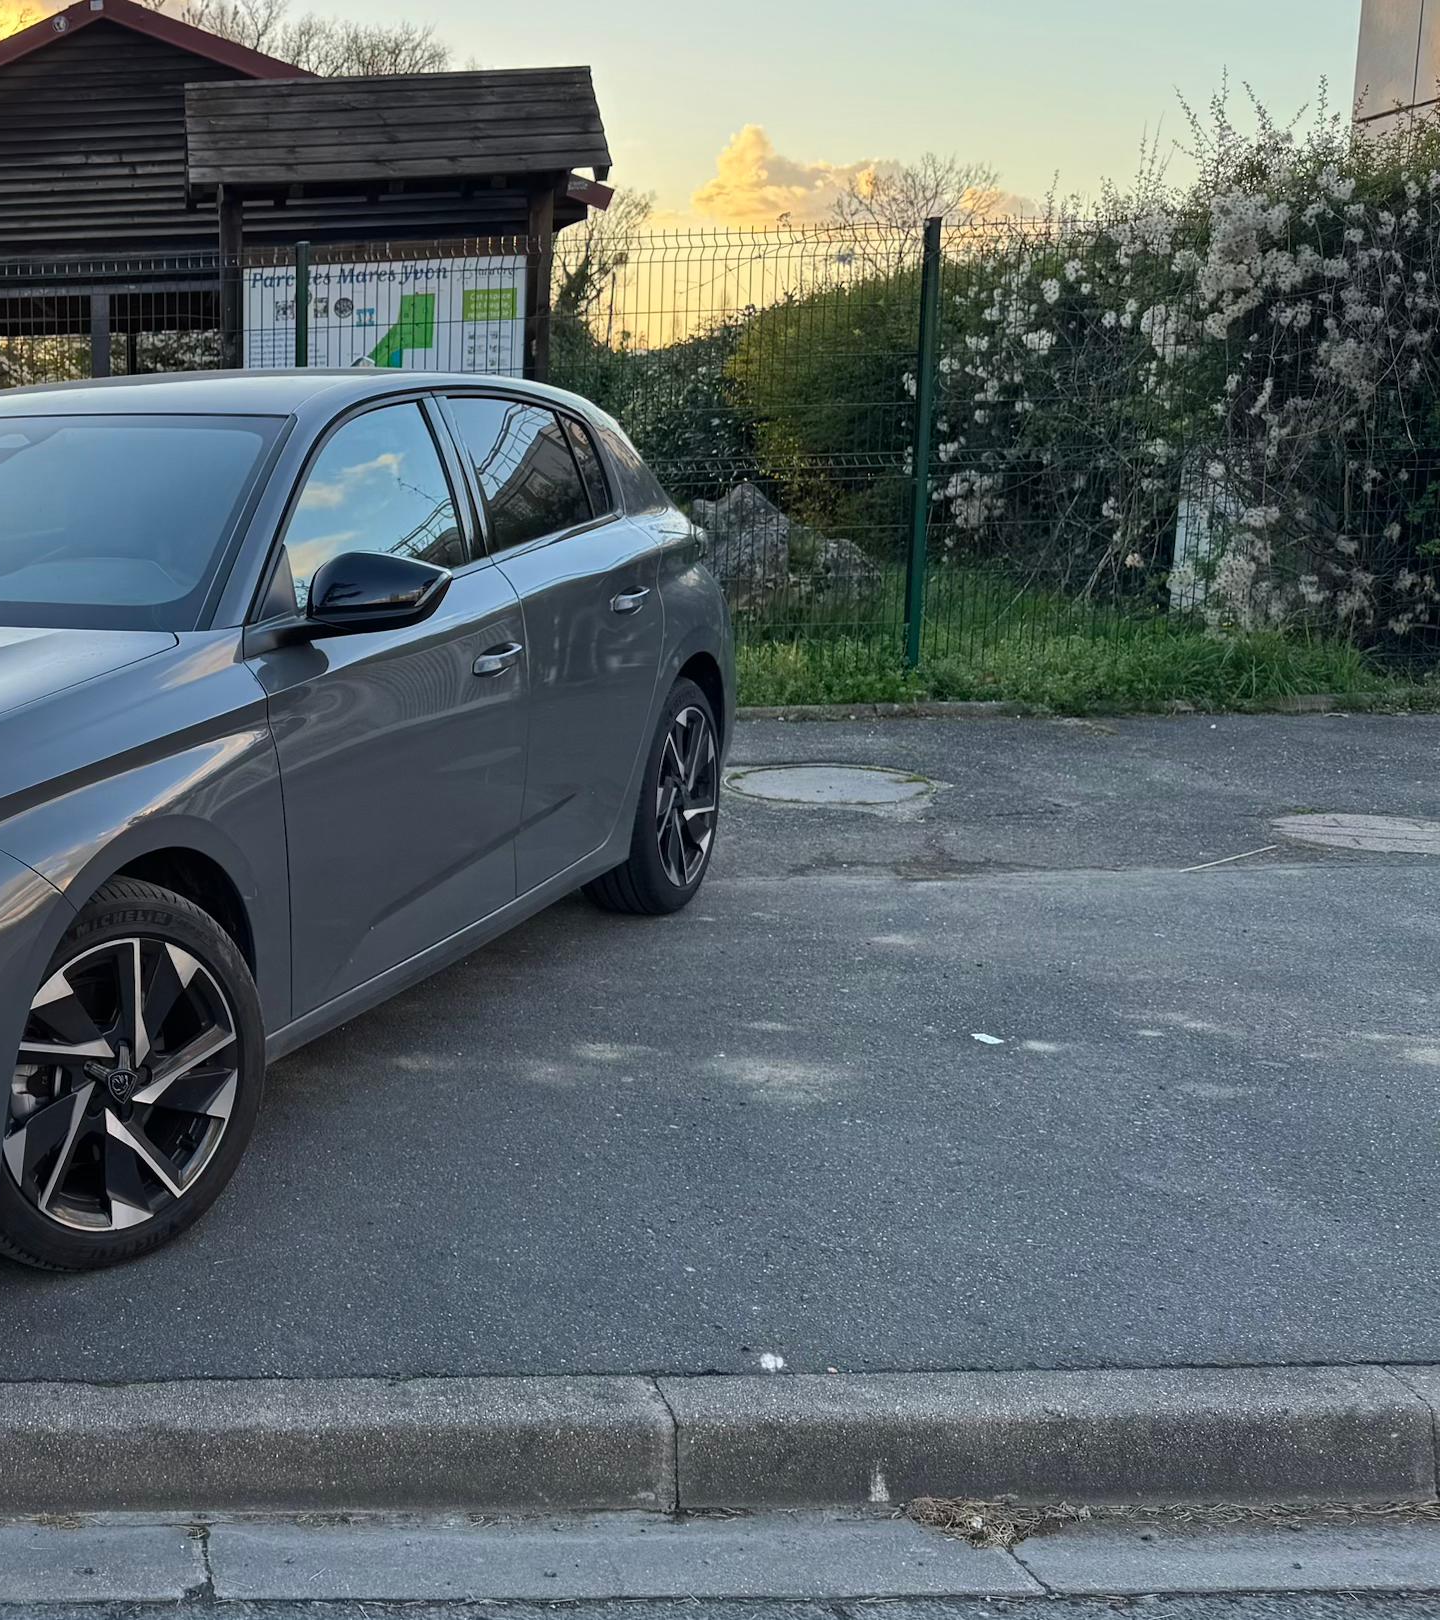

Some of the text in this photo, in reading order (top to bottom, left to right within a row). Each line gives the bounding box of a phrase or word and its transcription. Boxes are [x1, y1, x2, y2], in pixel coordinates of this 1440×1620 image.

[251, 272, 295, 288] Parc
[336, 267, 396, 285] Mares
[398, 264, 448, 285] Yvon
[75, 910, 173, 938] MICHELIN
